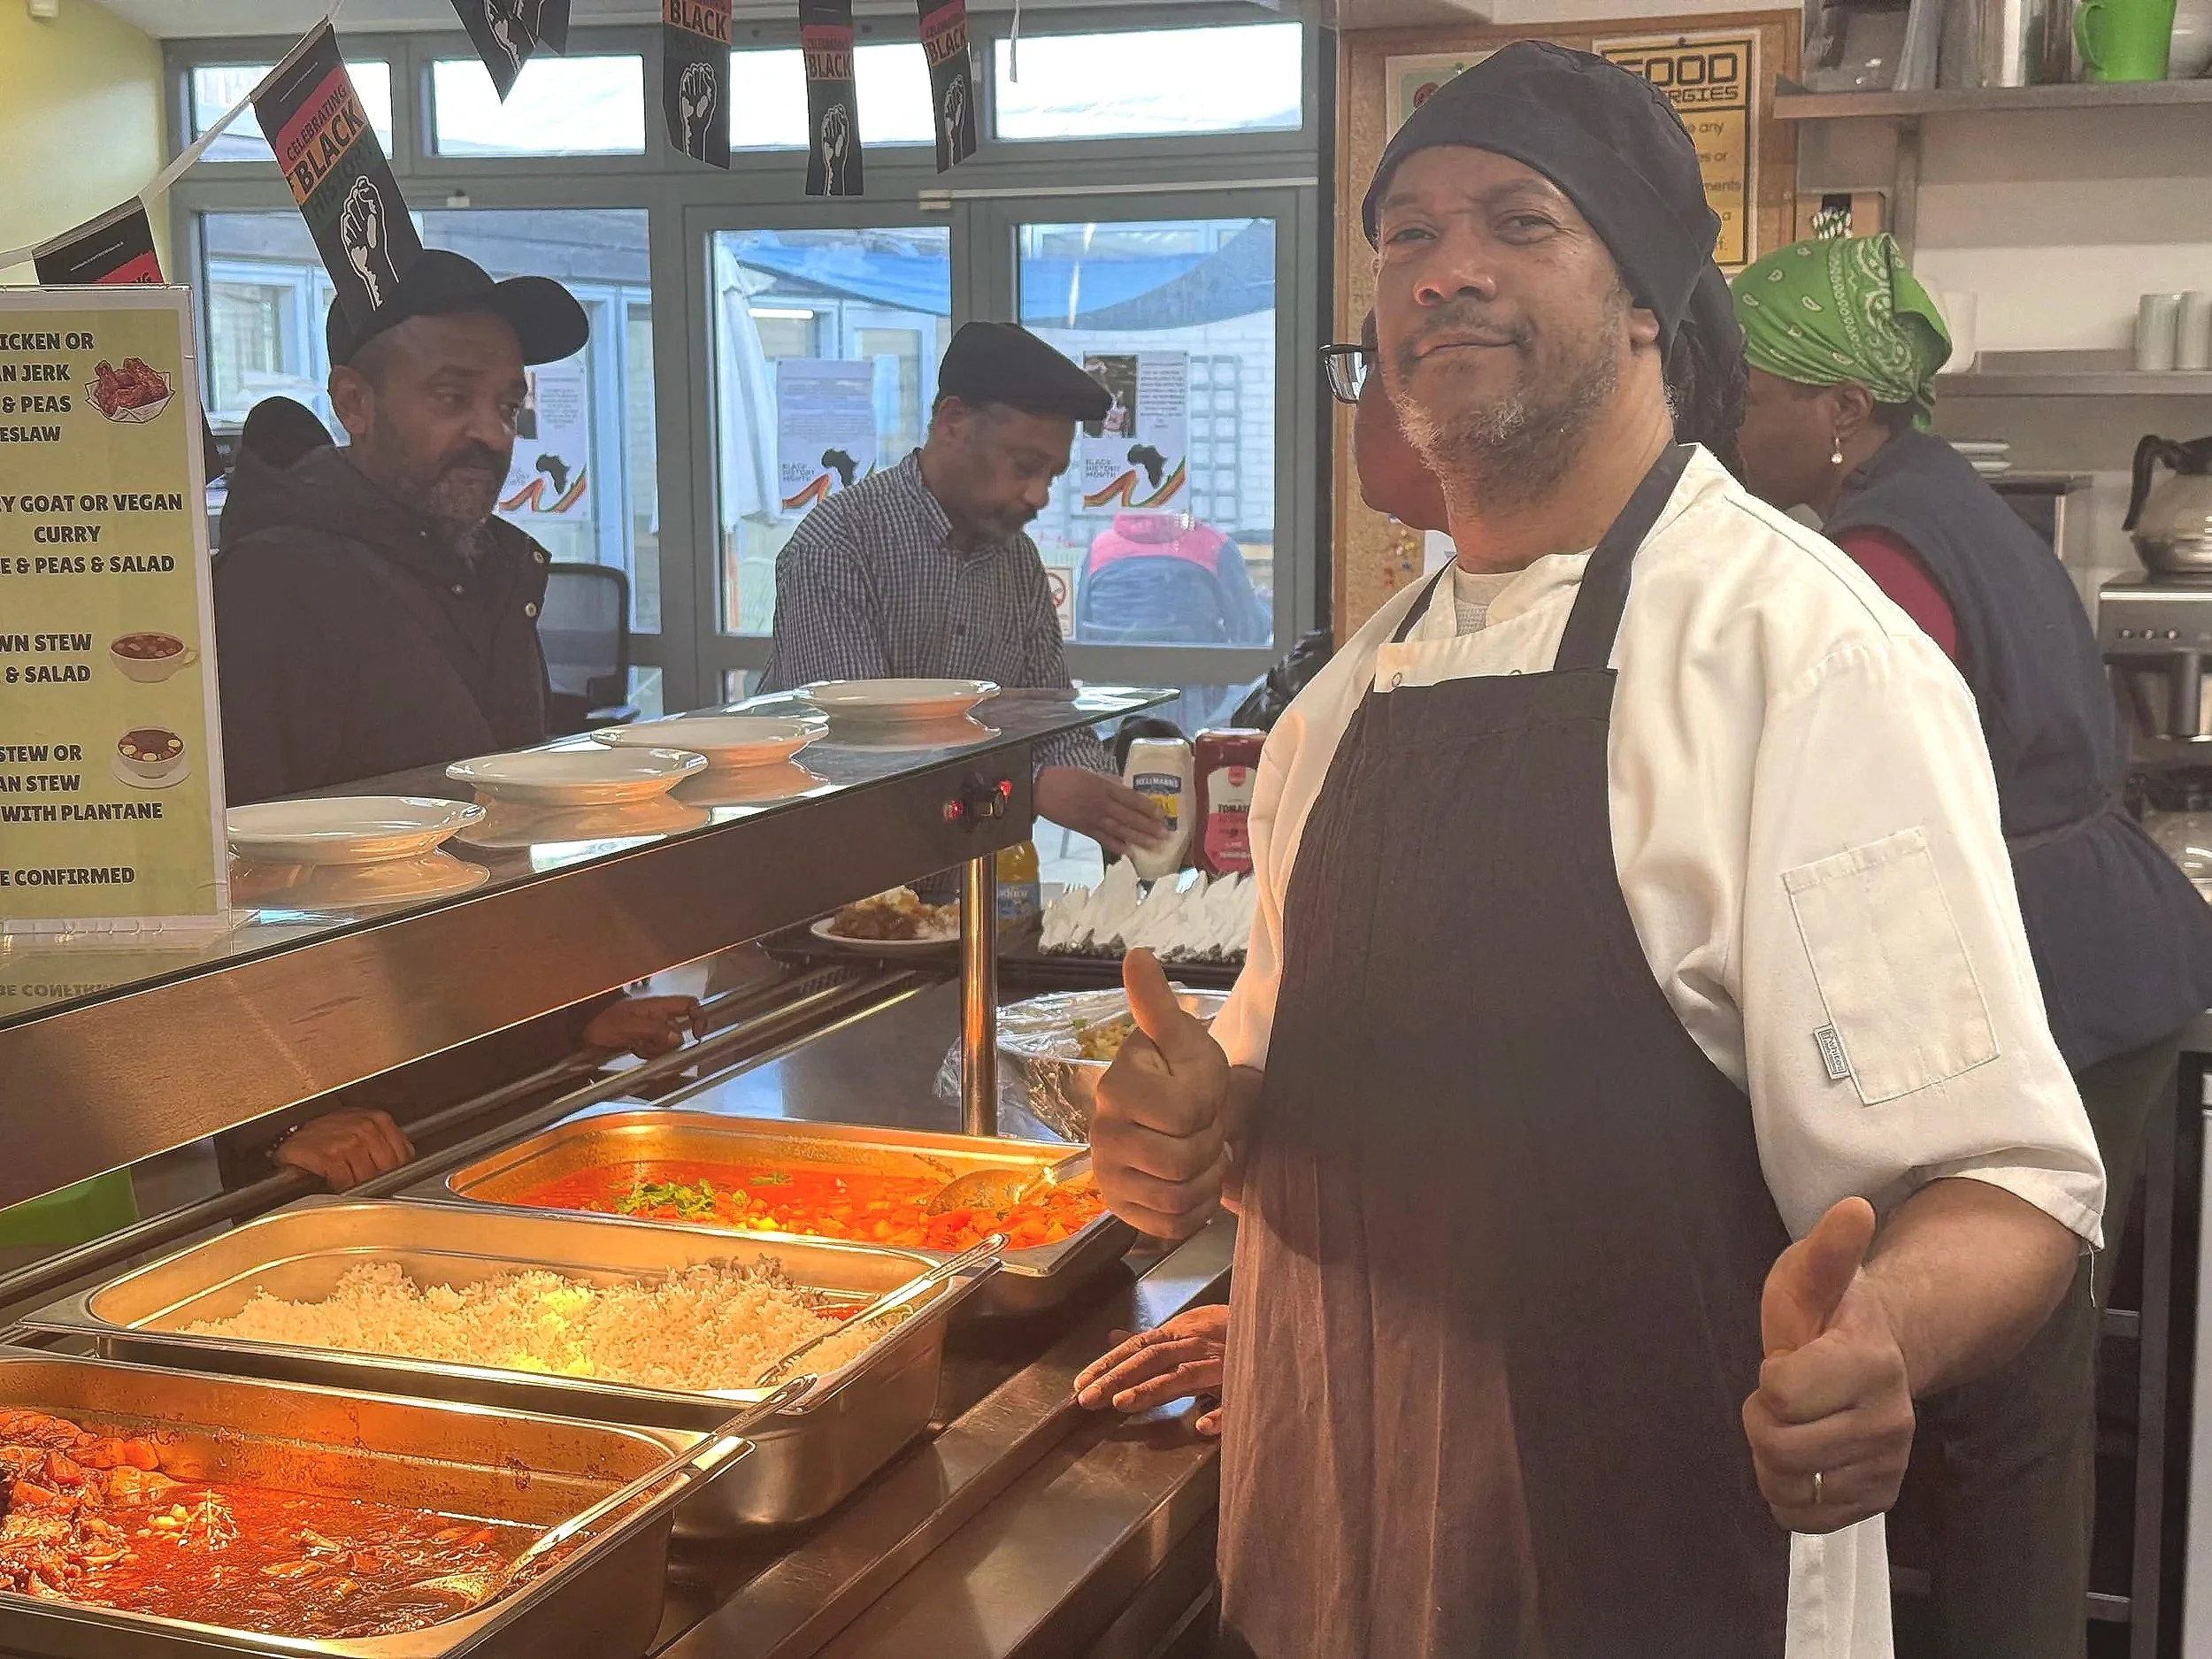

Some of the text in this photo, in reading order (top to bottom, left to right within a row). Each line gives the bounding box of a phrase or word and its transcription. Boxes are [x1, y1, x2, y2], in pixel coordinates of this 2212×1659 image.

[669, 0, 727, 41] BLACK
[926, 24, 965, 65] BLACK
[808, 53, 851, 78] BLACK
[1664, 86, 1739, 103] RGIES
[286, 84, 347, 162] CELEBRATING
[294, 98, 365, 196] BLACK
[65, 332, 95, 350] OR
[21, 364, 71, 382] JERK
[2, 396, 72, 412] & PEAS
[20, 495, 75, 512] GOAT
[80, 495, 109, 511] OR
[112, 494, 182, 511] VEGAN
[34, 526, 101, 542] CURRY
[16, 557, 30, 573] &
[35, 557, 86, 573] PEAS
[90, 556, 104, 573] &
[110, 556, 174, 572] SALAD
[35, 634, 92, 652] STEW
[5, 665, 91, 683] & SALAD
[53, 744, 82, 761] OR
[26, 774, 81, 792] STEW
[1, 803, 163, 822] WITH PLANTANE
[1217, 803, 1248, 814] TOMAT
[14, 867, 134, 887] CONFIRMED
